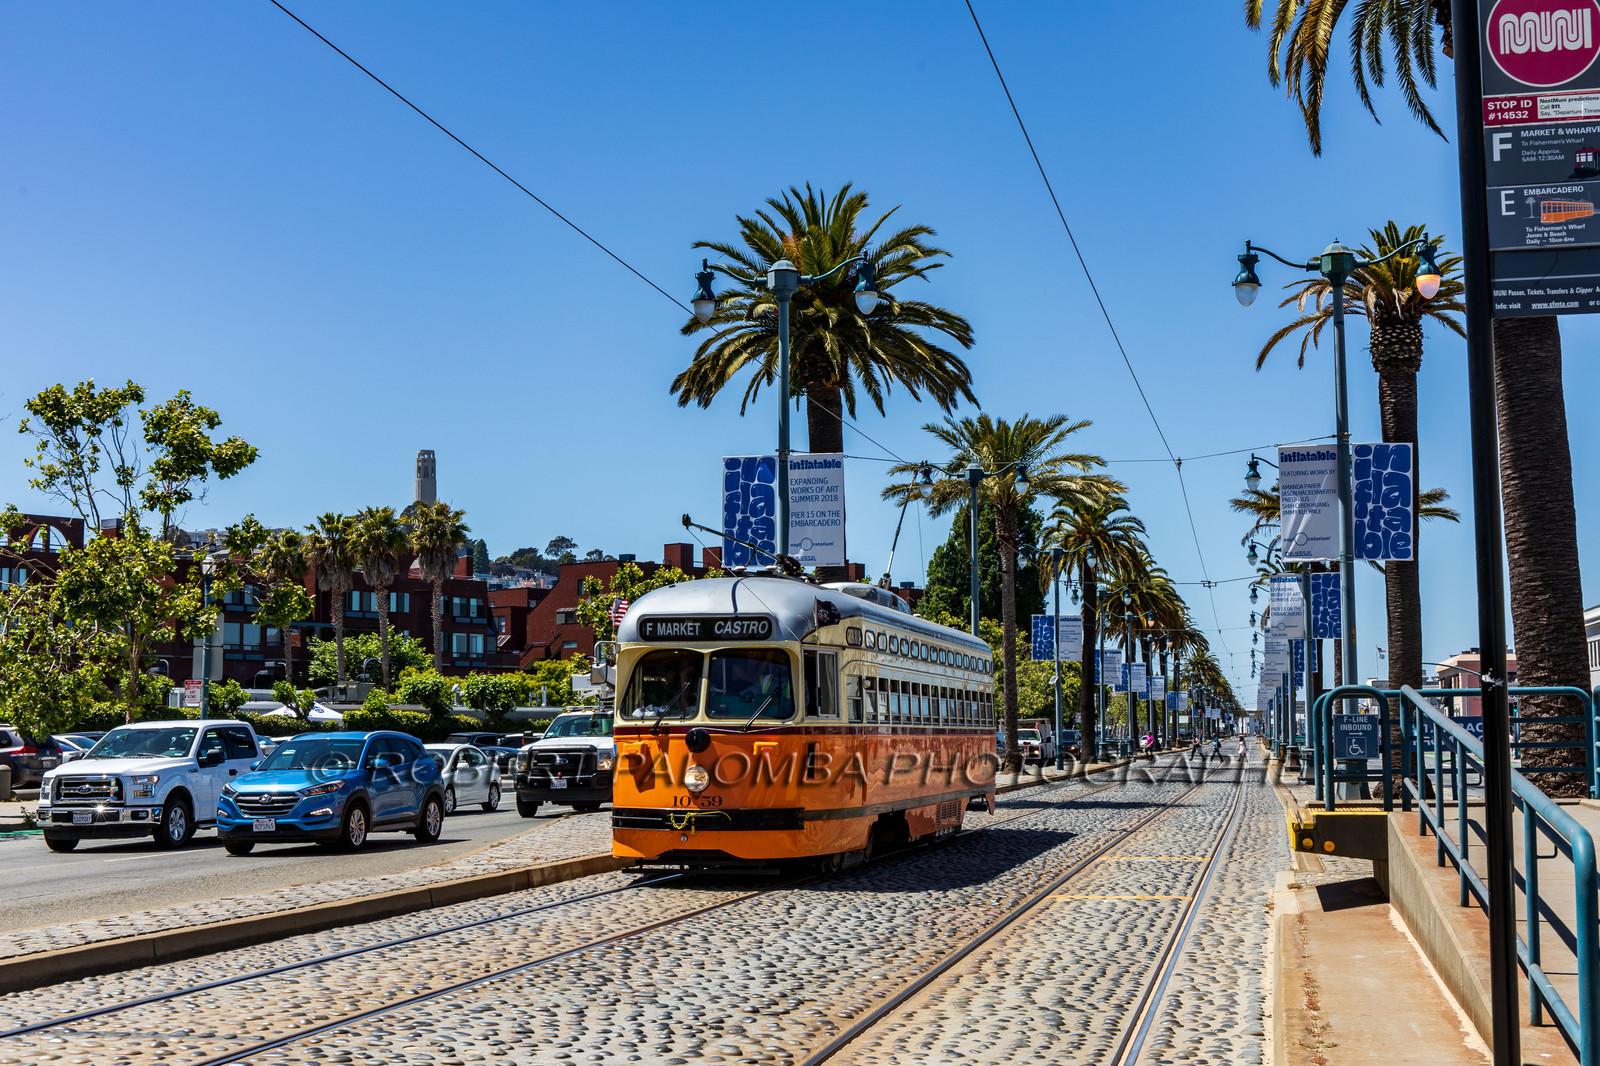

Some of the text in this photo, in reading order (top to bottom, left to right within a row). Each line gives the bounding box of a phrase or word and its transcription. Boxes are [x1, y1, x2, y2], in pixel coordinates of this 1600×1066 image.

[1499, 8, 1592, 55] MUNI
[1488, 100, 1533, 110] STOP ID
[1488, 110, 1529, 121] #14532
[1521, 129, 1555, 138] MARKET
[1557, 127, 1565, 135] &
[1492, 132, 1512, 162] F
[1524, 186, 1584, 196] EMBARCADERO
[1501, 190, 1516, 216] E
[1534, 224, 1567, 232] Fisherman's
[1576, 286, 1594, 294] Clipper
[1509, 302, 1521, 310] visit
[1531, 300, 1579, 310] www.sfmta.com
[1280, 451, 1337, 463] inflatable
[790, 459, 842, 471] inflatable
[1281, 467, 1337, 478] FEATURING WORKS BY
[791, 477, 829, 487] EXPANDING
[1281, 483, 1304, 491] AMANDA
[791, 485, 839, 495] WORKS OF ART
[1282, 490, 1298, 498] JASON
[791, 494, 839, 504] SUMMER 2018
[791, 510, 841, 521] PIER 15 ON THE
[791, 518, 842, 529] EMBARCADERO
[645, 620, 769, 636] F MARKET CASTRO
[1340, 723, 1373, 731] INBOUND
